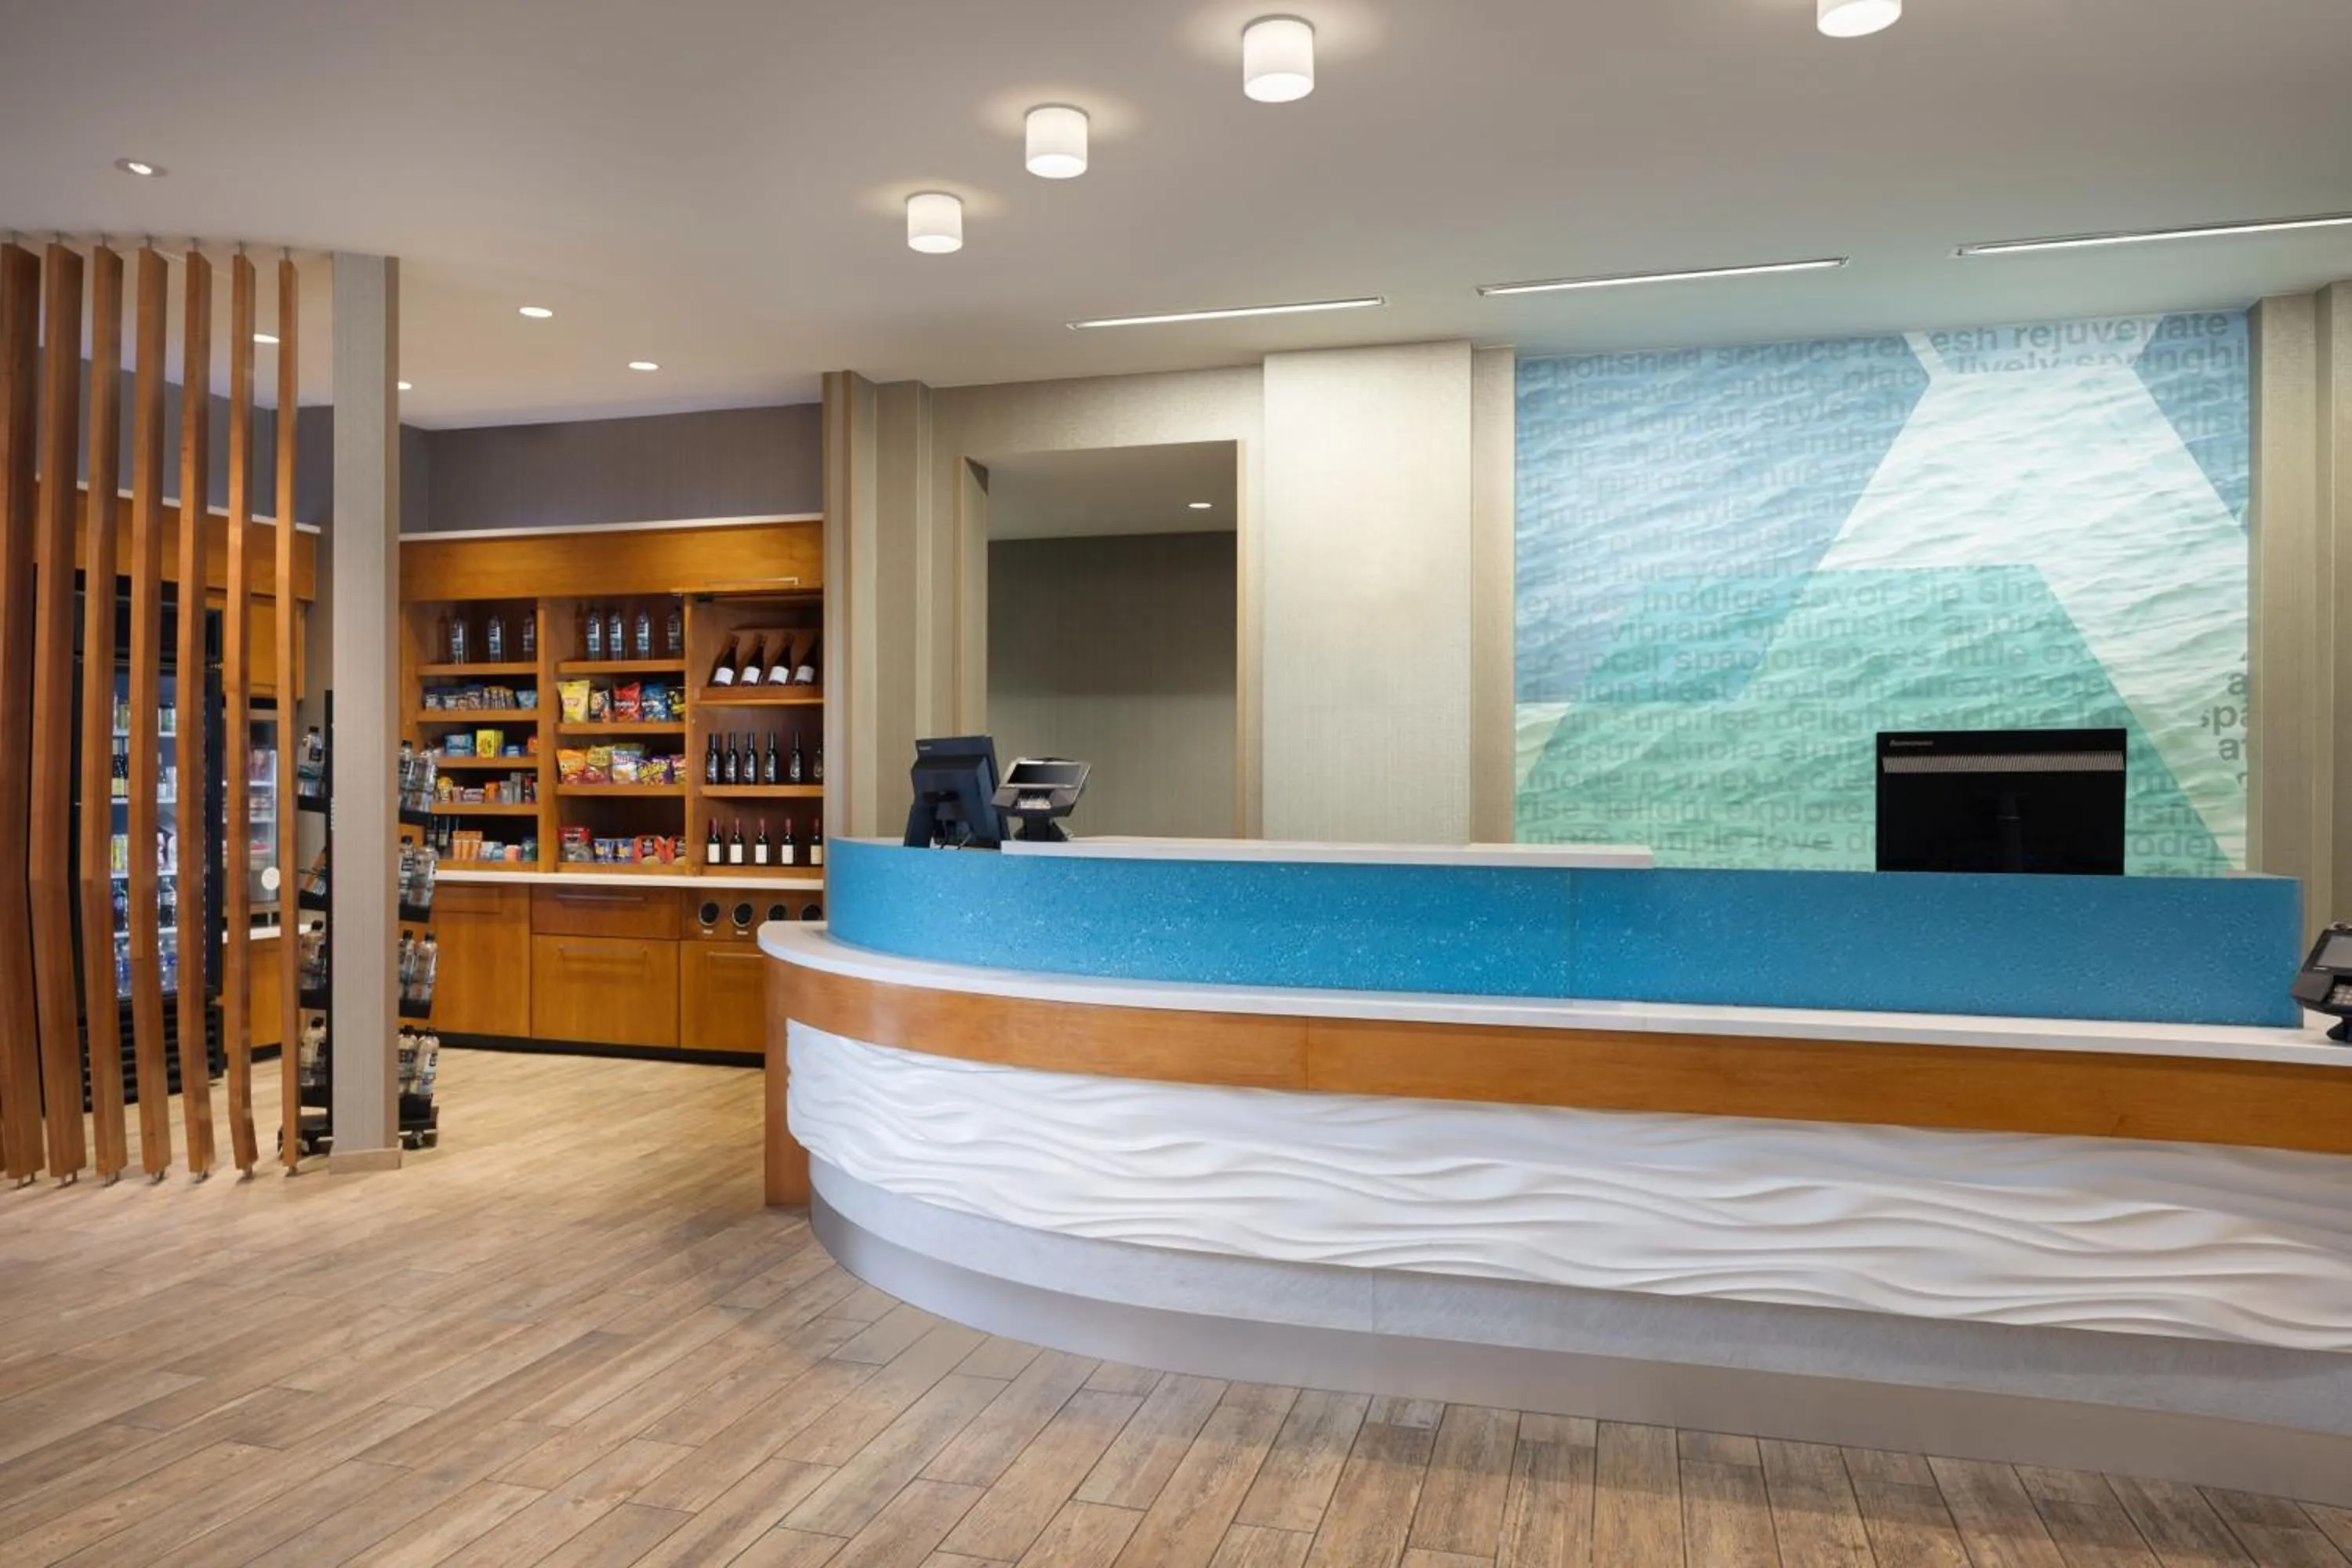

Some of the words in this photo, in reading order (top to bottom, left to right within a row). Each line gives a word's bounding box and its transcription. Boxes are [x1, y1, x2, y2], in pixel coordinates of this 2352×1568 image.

[1716, 338, 1848, 368] service
[1761, 395, 1848, 431] style
[1644, 583, 1776, 617] indulge
[1609, 613, 1733, 645] vibrant
[1747, 605, 1929, 646] optimistic
[1584, 644, 1663, 673] local
[1614, 702, 1762, 739] surprise
[1775, 696, 1900, 735] delight
[1726, 793, 1864, 829] explore
[1758, 826, 1833, 855] love
